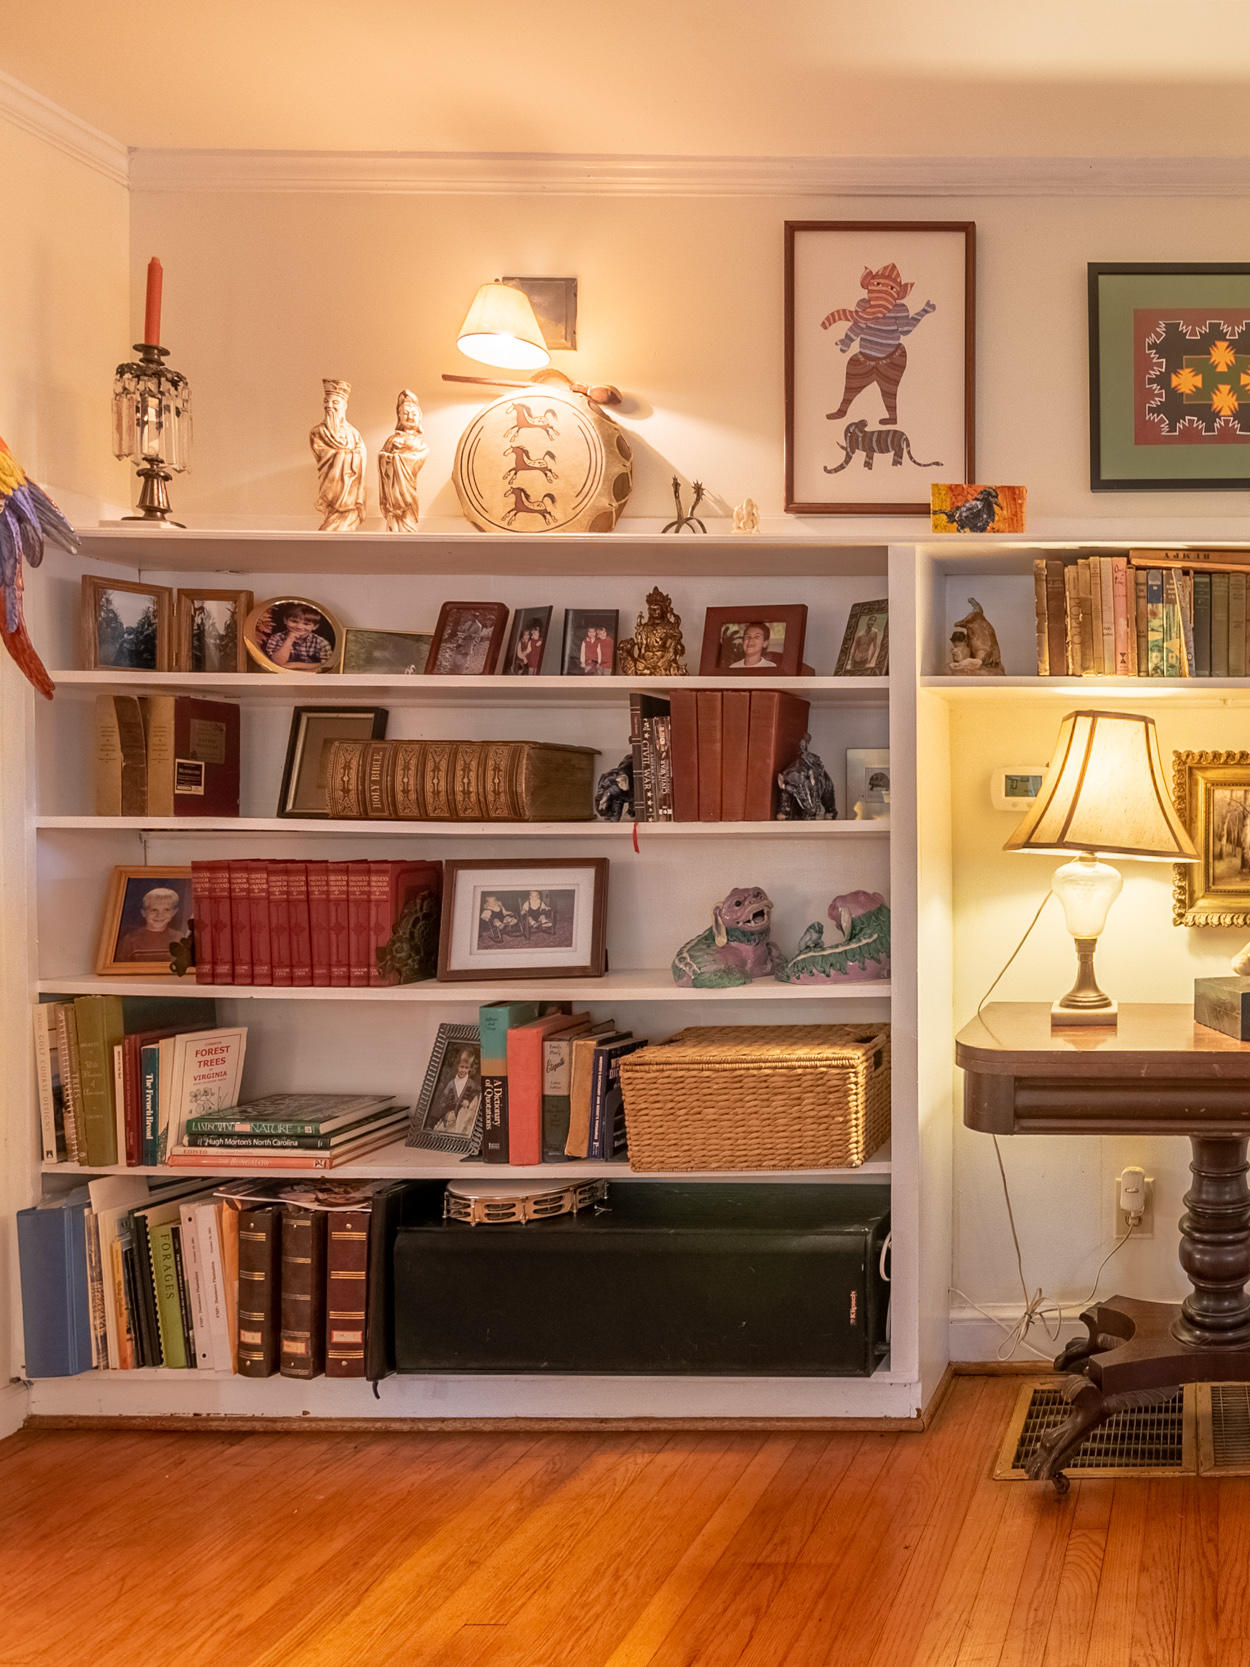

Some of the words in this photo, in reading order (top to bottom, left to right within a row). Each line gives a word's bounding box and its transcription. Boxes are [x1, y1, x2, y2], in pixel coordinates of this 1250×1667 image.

[642, 740, 650, 766] CIVIL
[643, 768, 652, 790] WAR
[370, 784, 382, 808] HOLY
[38, 1034, 46, 1056] GOLF
[195, 1045, 231, 1058] FOREST
[197, 1057, 226, 1069] TREES
[40, 1060, 48, 1092] COURSE
[146, 1074, 154, 1088] The
[193, 1070, 228, 1081] VIRGINIA
[42, 1096, 51, 1132] DESIGNS
[146, 1089, 154, 1116] French
[485, 1089, 494, 1130] Quotations
[493, 1088, 503, 1127] Dictionary
[250, 1122, 292, 1134] NATURE
[205, 1138, 224, 1147] Hugh
[224, 1138, 253, 1146] Morton's
[253, 1138, 272, 1146] North
[272, 1138, 298, 1146] Carolina
[161, 1233, 175, 1300] FORAGES
